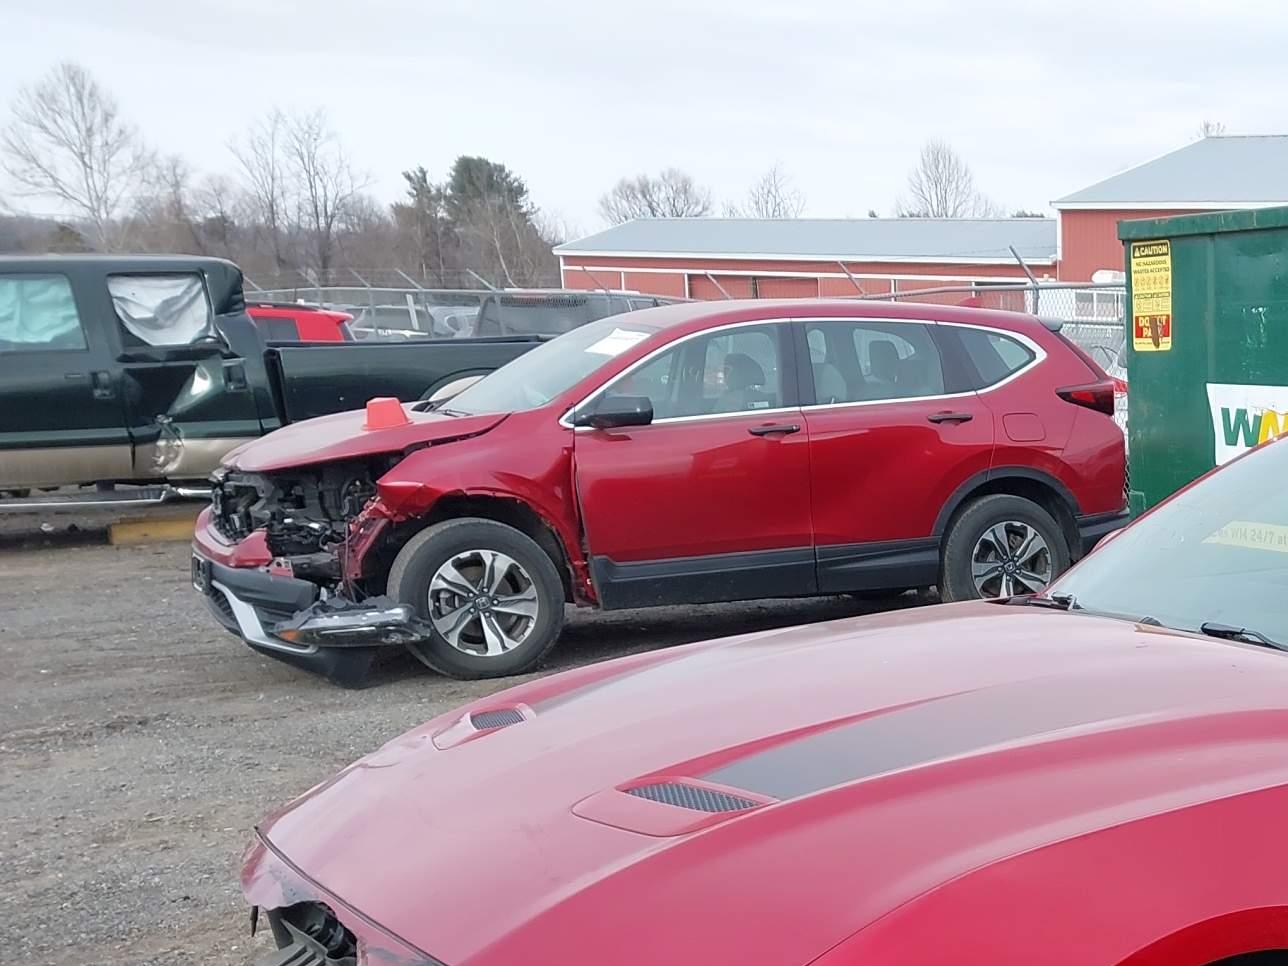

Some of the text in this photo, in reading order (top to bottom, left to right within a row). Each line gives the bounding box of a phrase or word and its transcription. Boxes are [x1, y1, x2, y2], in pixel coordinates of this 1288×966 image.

[1140, 244, 1168, 256] CAUTION
[1138, 316, 1150, 327] DO
[1251, 529, 1274, 544] 24/7
[1277, 534, 1287, 545] at
